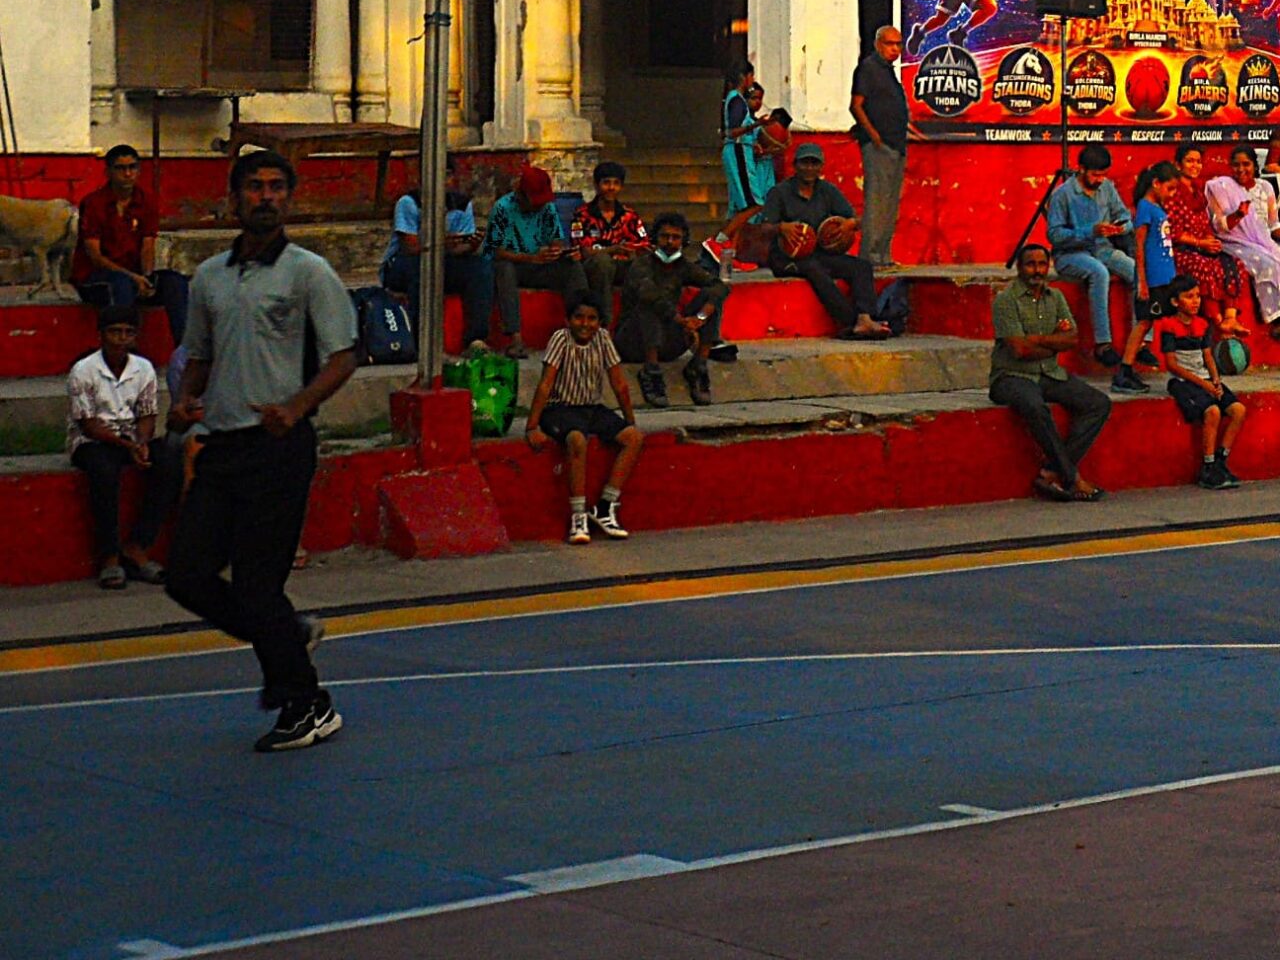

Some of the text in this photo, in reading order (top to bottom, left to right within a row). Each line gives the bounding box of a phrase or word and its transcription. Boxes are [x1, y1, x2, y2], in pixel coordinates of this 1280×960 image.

[916, 76, 979, 98] TITANS
[994, 82, 1052, 101] STALLIONS
[1180, 85, 1227, 103] BLAZERS
[1238, 85, 1280, 104] KINGS
[934, 96, 960, 107] THDBA
[984, 128, 1032, 142] TEAMWORK
[1131, 129, 1166, 142] RESPECT
[1191, 130, 1223, 142] PASSION
[1248, 129, 1273, 140] EXCEL
